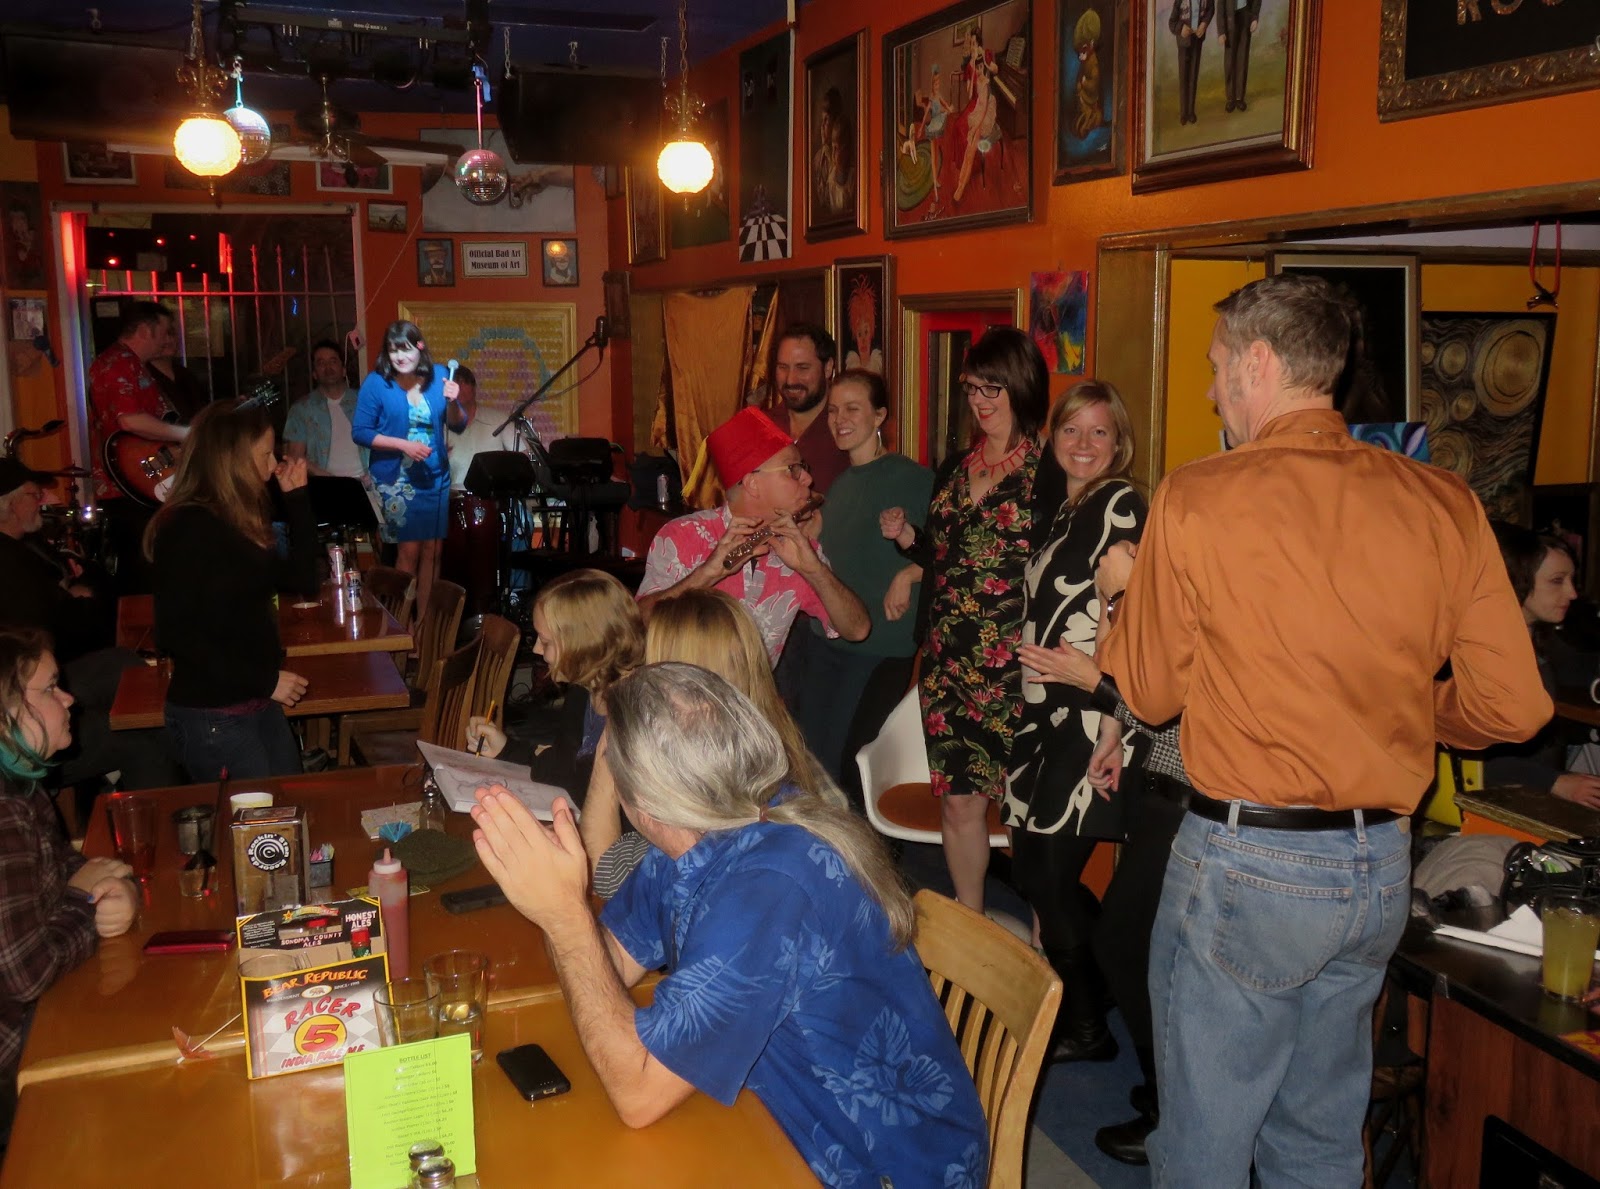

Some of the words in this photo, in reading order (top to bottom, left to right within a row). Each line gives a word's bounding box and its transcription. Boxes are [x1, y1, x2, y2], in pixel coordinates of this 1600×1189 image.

[495, 249, 510, 258] Bad
[511, 249, 521, 258] Art
[471, 261, 499, 269] Museum
[500, 261, 508, 269] of
[510, 261, 520, 269] Art
[345, 910, 377, 923] HONEST
[351, 918, 372, 929] ALES
[281, 936, 310, 946] SONOMA
[313, 931, 343, 941] COUNTY
[302, 940, 322, 948] ALES
[262, 978, 301, 999] BEAR
[302, 969, 368, 987] REPUBLIC
[284, 996, 361, 1031] RACER
[301, 1024, 340, 1052] 5
[281, 1054, 313, 1069] INDIA
[316, 1048, 344, 1062] PALE
[399, 1055, 420, 1063] BOTTLE
